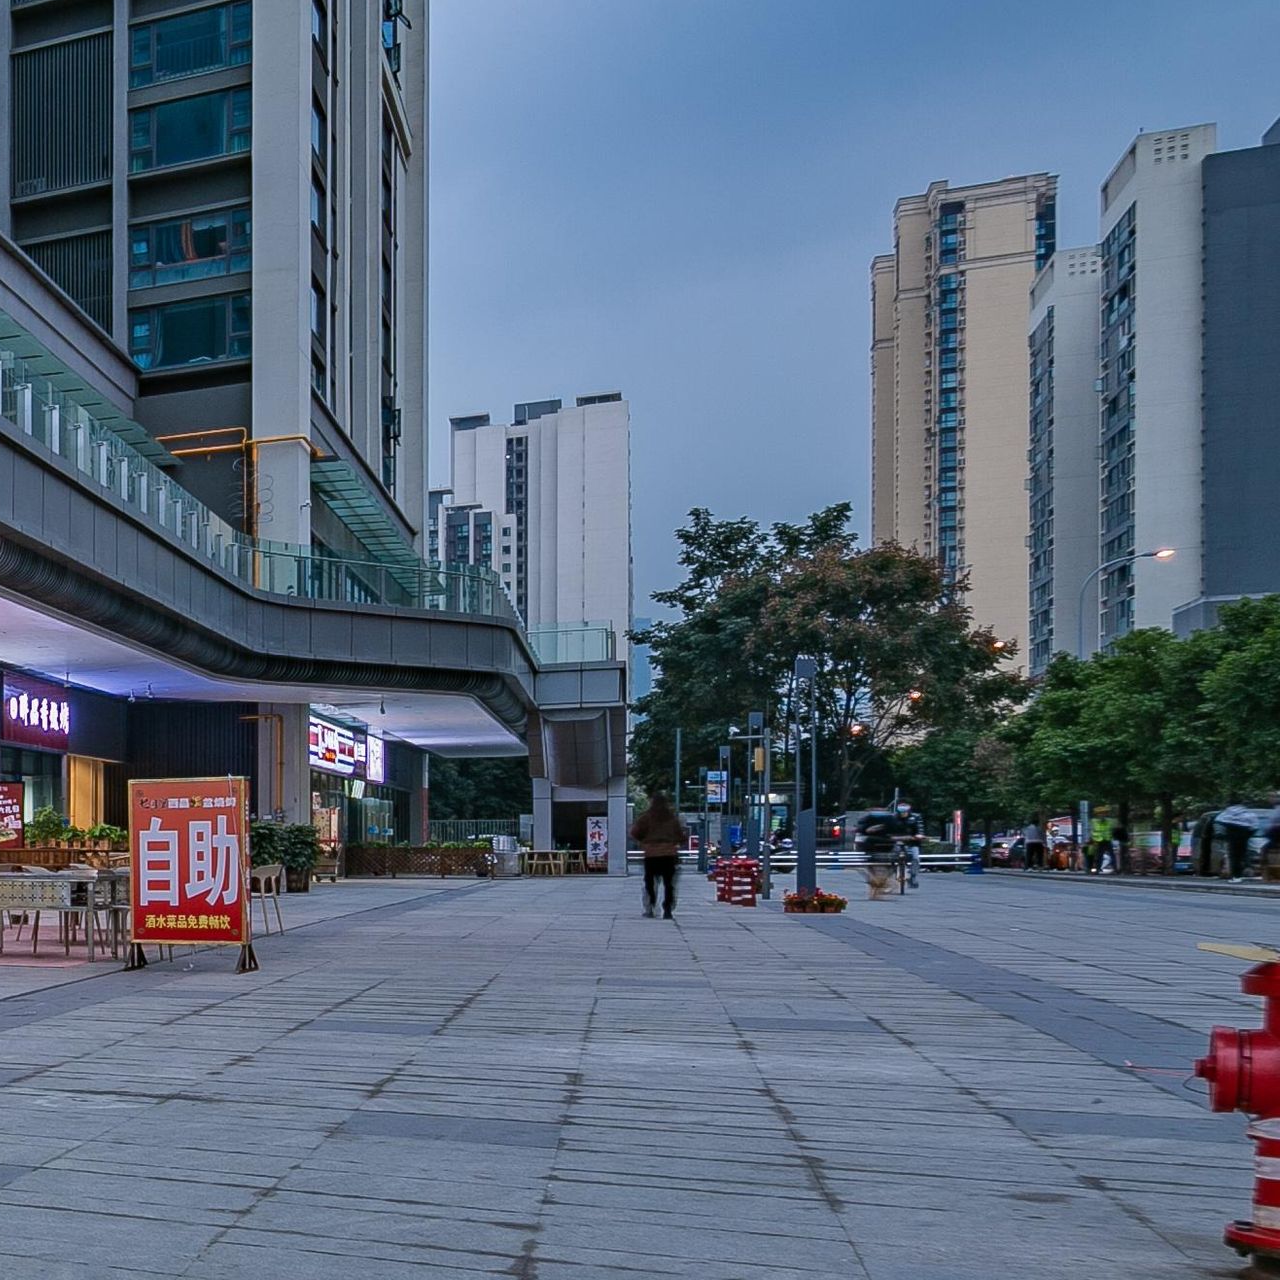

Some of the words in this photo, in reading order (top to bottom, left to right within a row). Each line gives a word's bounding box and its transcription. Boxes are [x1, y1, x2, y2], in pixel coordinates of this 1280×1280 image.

[139, 815, 239, 907] 自助
[145, 914, 231, 929] 酒水菜品免费畅饮
